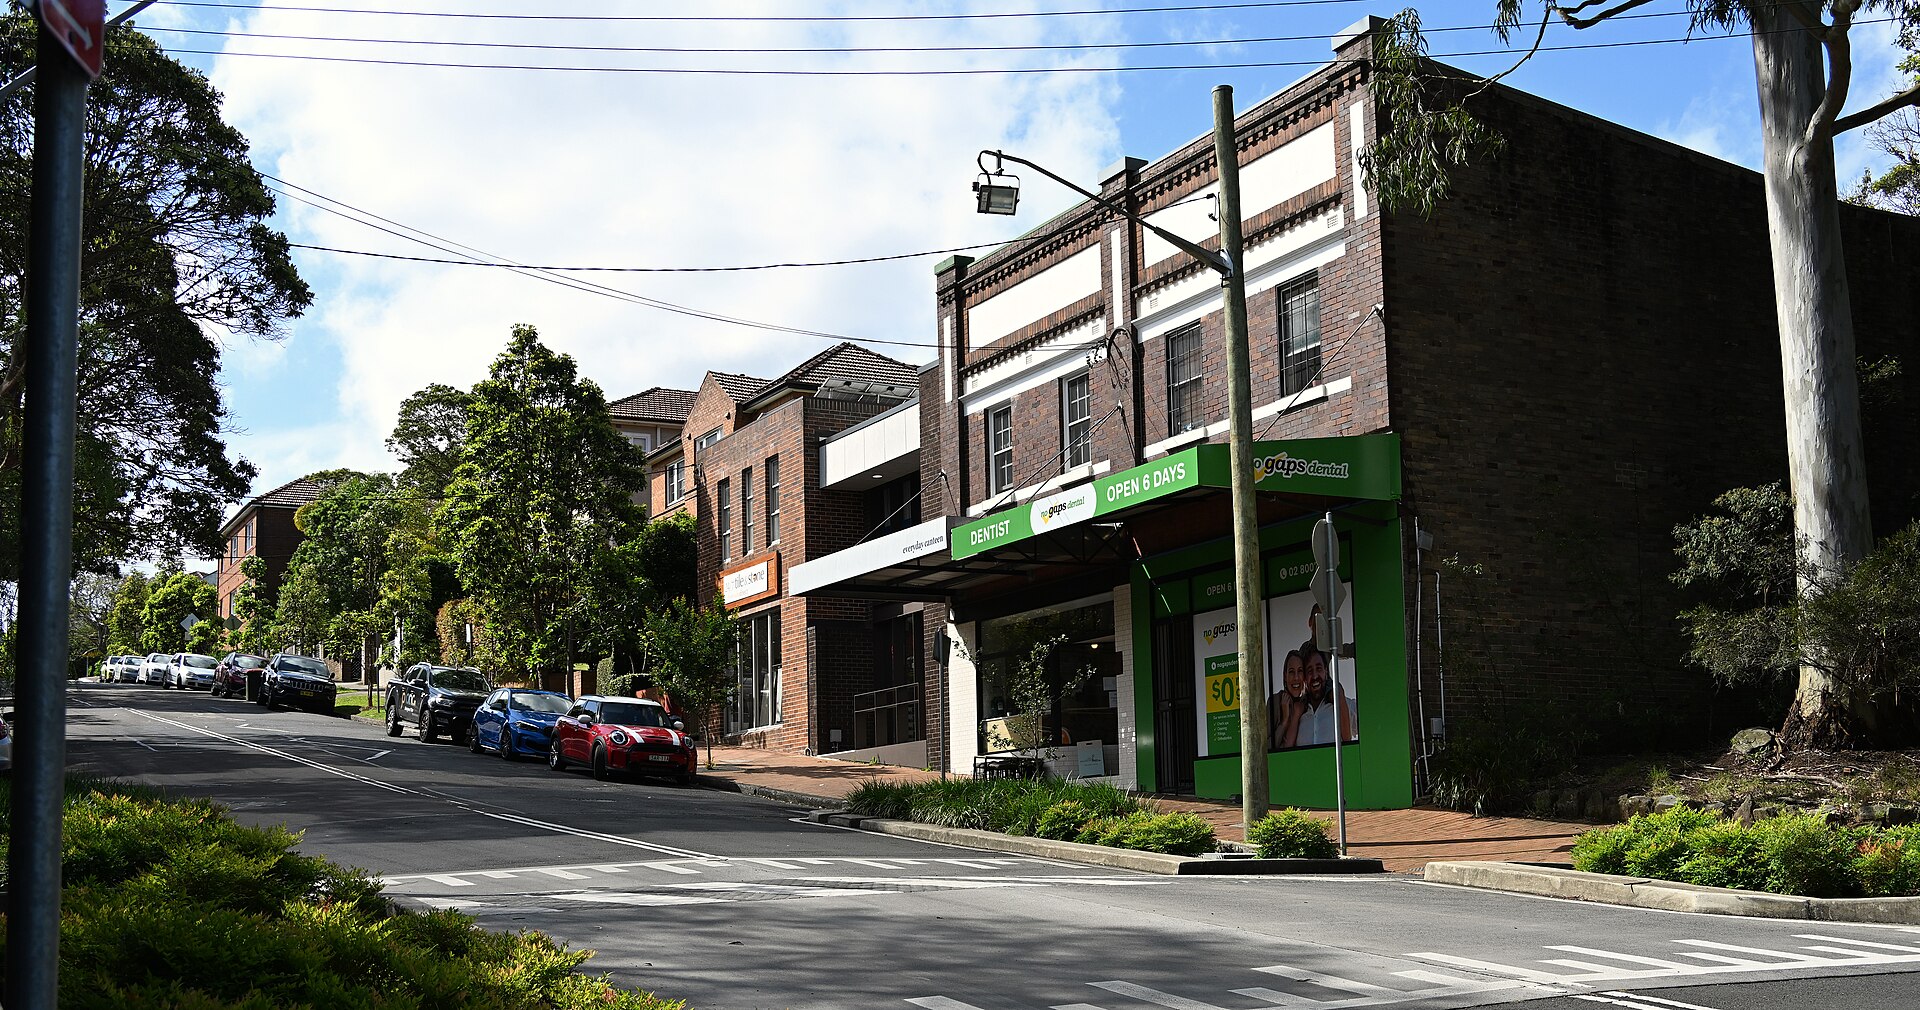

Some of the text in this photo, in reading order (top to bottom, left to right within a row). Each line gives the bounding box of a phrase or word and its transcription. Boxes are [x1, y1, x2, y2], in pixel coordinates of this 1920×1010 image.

[1264, 457, 1306, 476] gaps
[1307, 461, 1348, 477] dental
[1106, 462, 1186, 502] OPEN 6 DAYS
[1040, 496, 1085, 518] no gaps dental
[970, 519, 1010, 546] DENTIST
[902, 535, 944, 554] everyday canteen
[734, 573, 744, 589] tile
[747, 569, 765, 585] stone
[1288, 565, 1298, 577] 02
[1206, 583, 1226, 596] OPEN
[1227, 582, 1232, 592] 6
[1203, 629, 1212, 638] no
[1213, 622, 1236, 638] gaps
